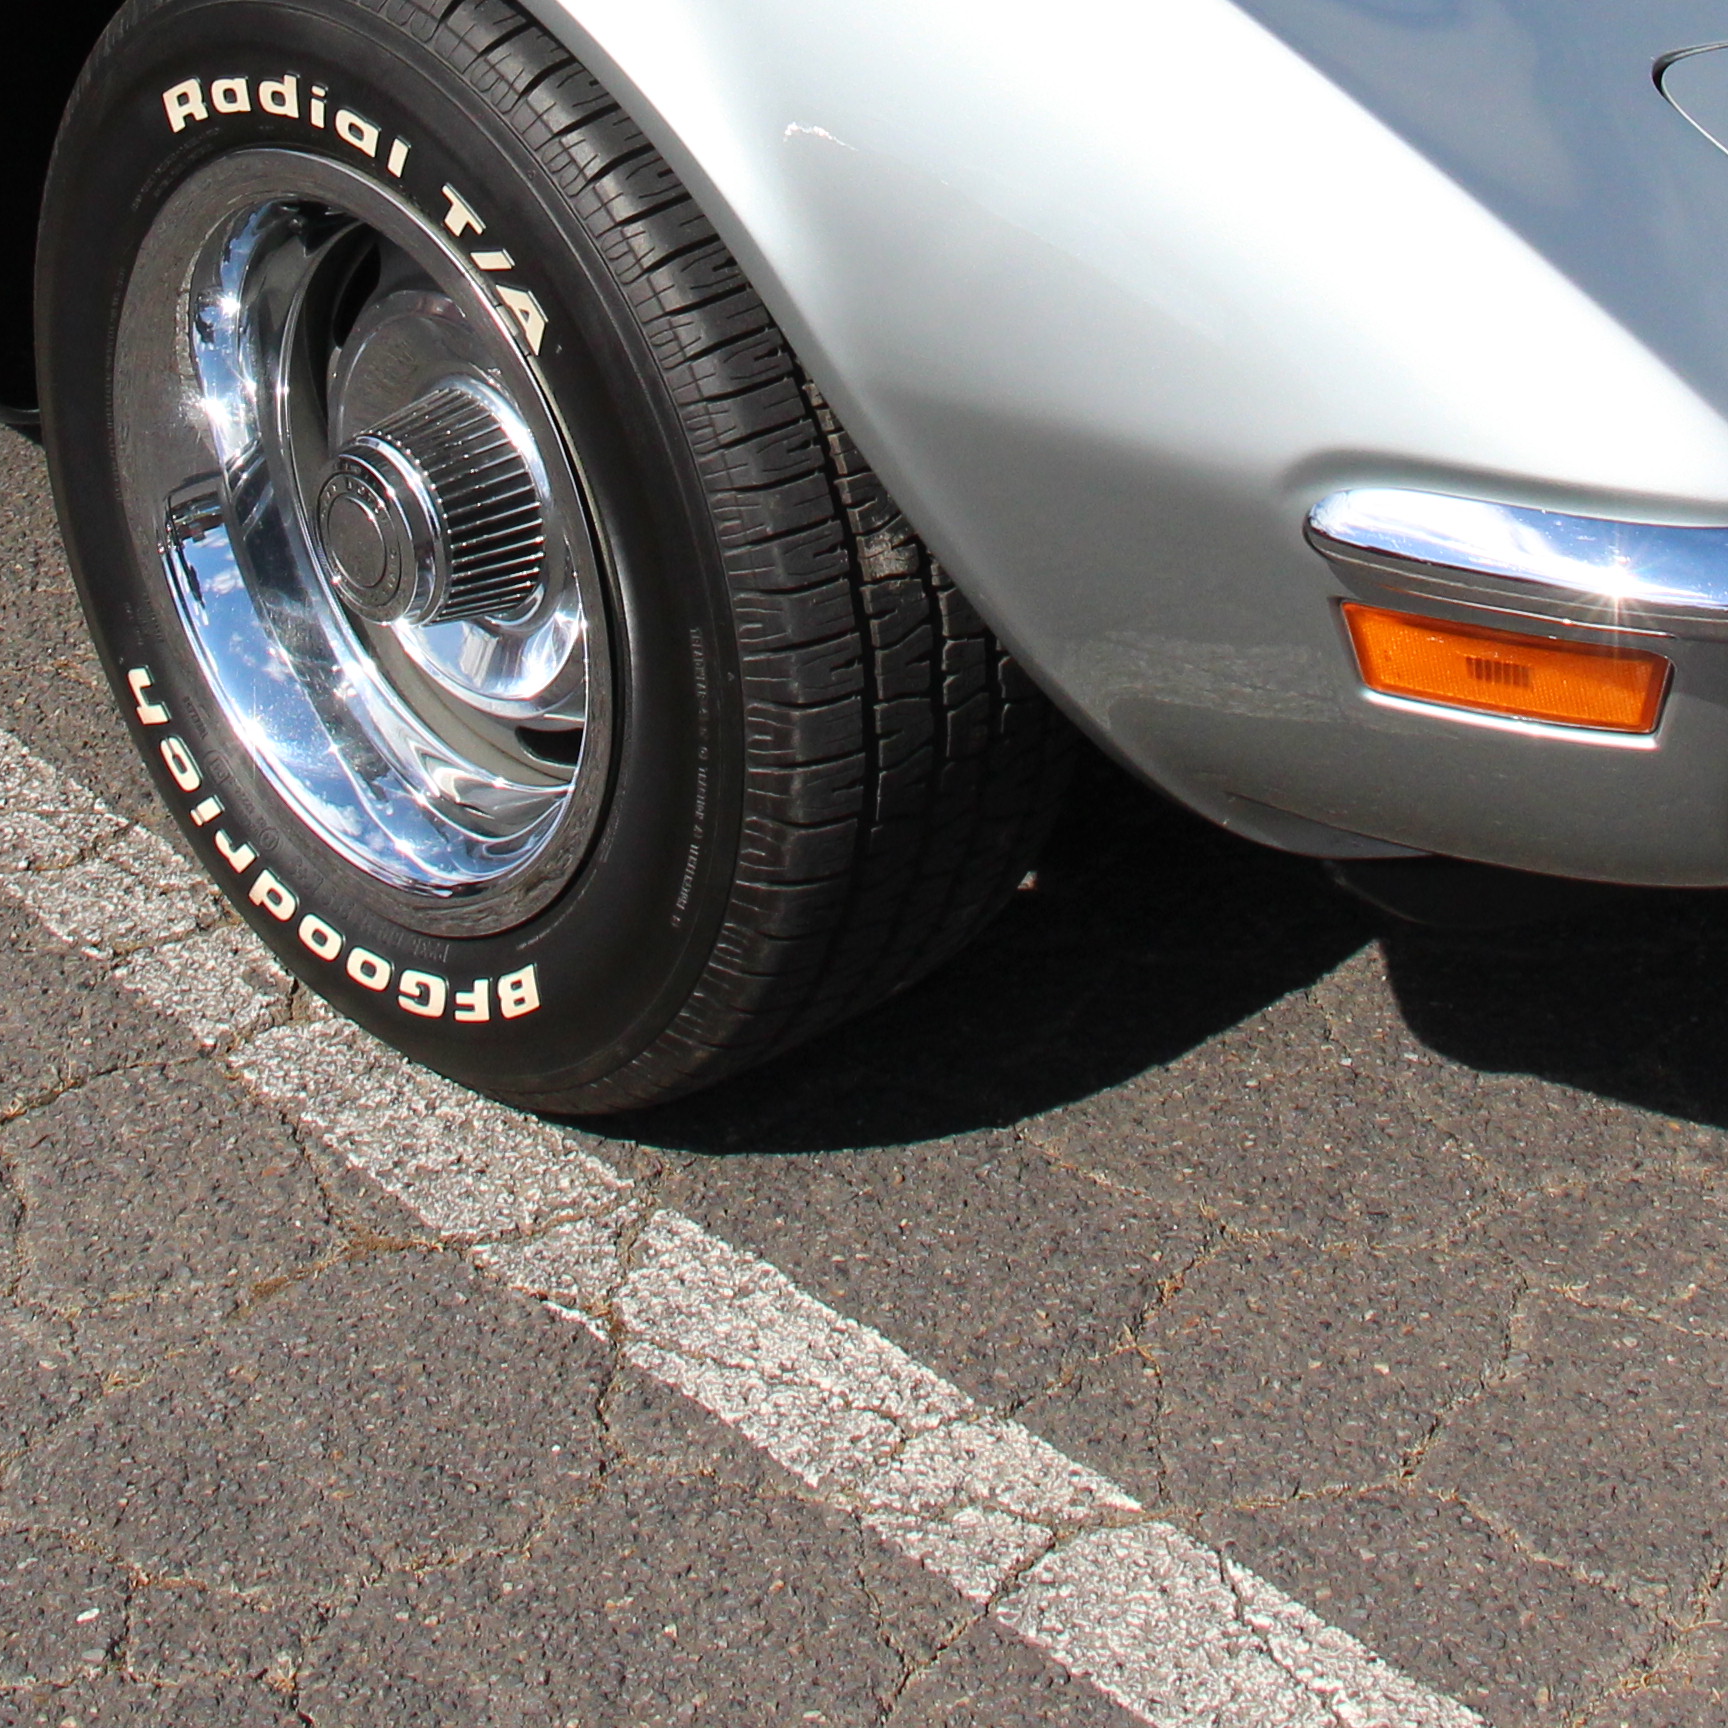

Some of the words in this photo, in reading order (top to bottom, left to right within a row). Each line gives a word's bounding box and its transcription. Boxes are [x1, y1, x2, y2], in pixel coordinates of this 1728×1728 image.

[161, 73, 412, 179] Radial
[441, 182, 549, 356] T/A
[126, 665, 542, 1023] BFGoodrich
